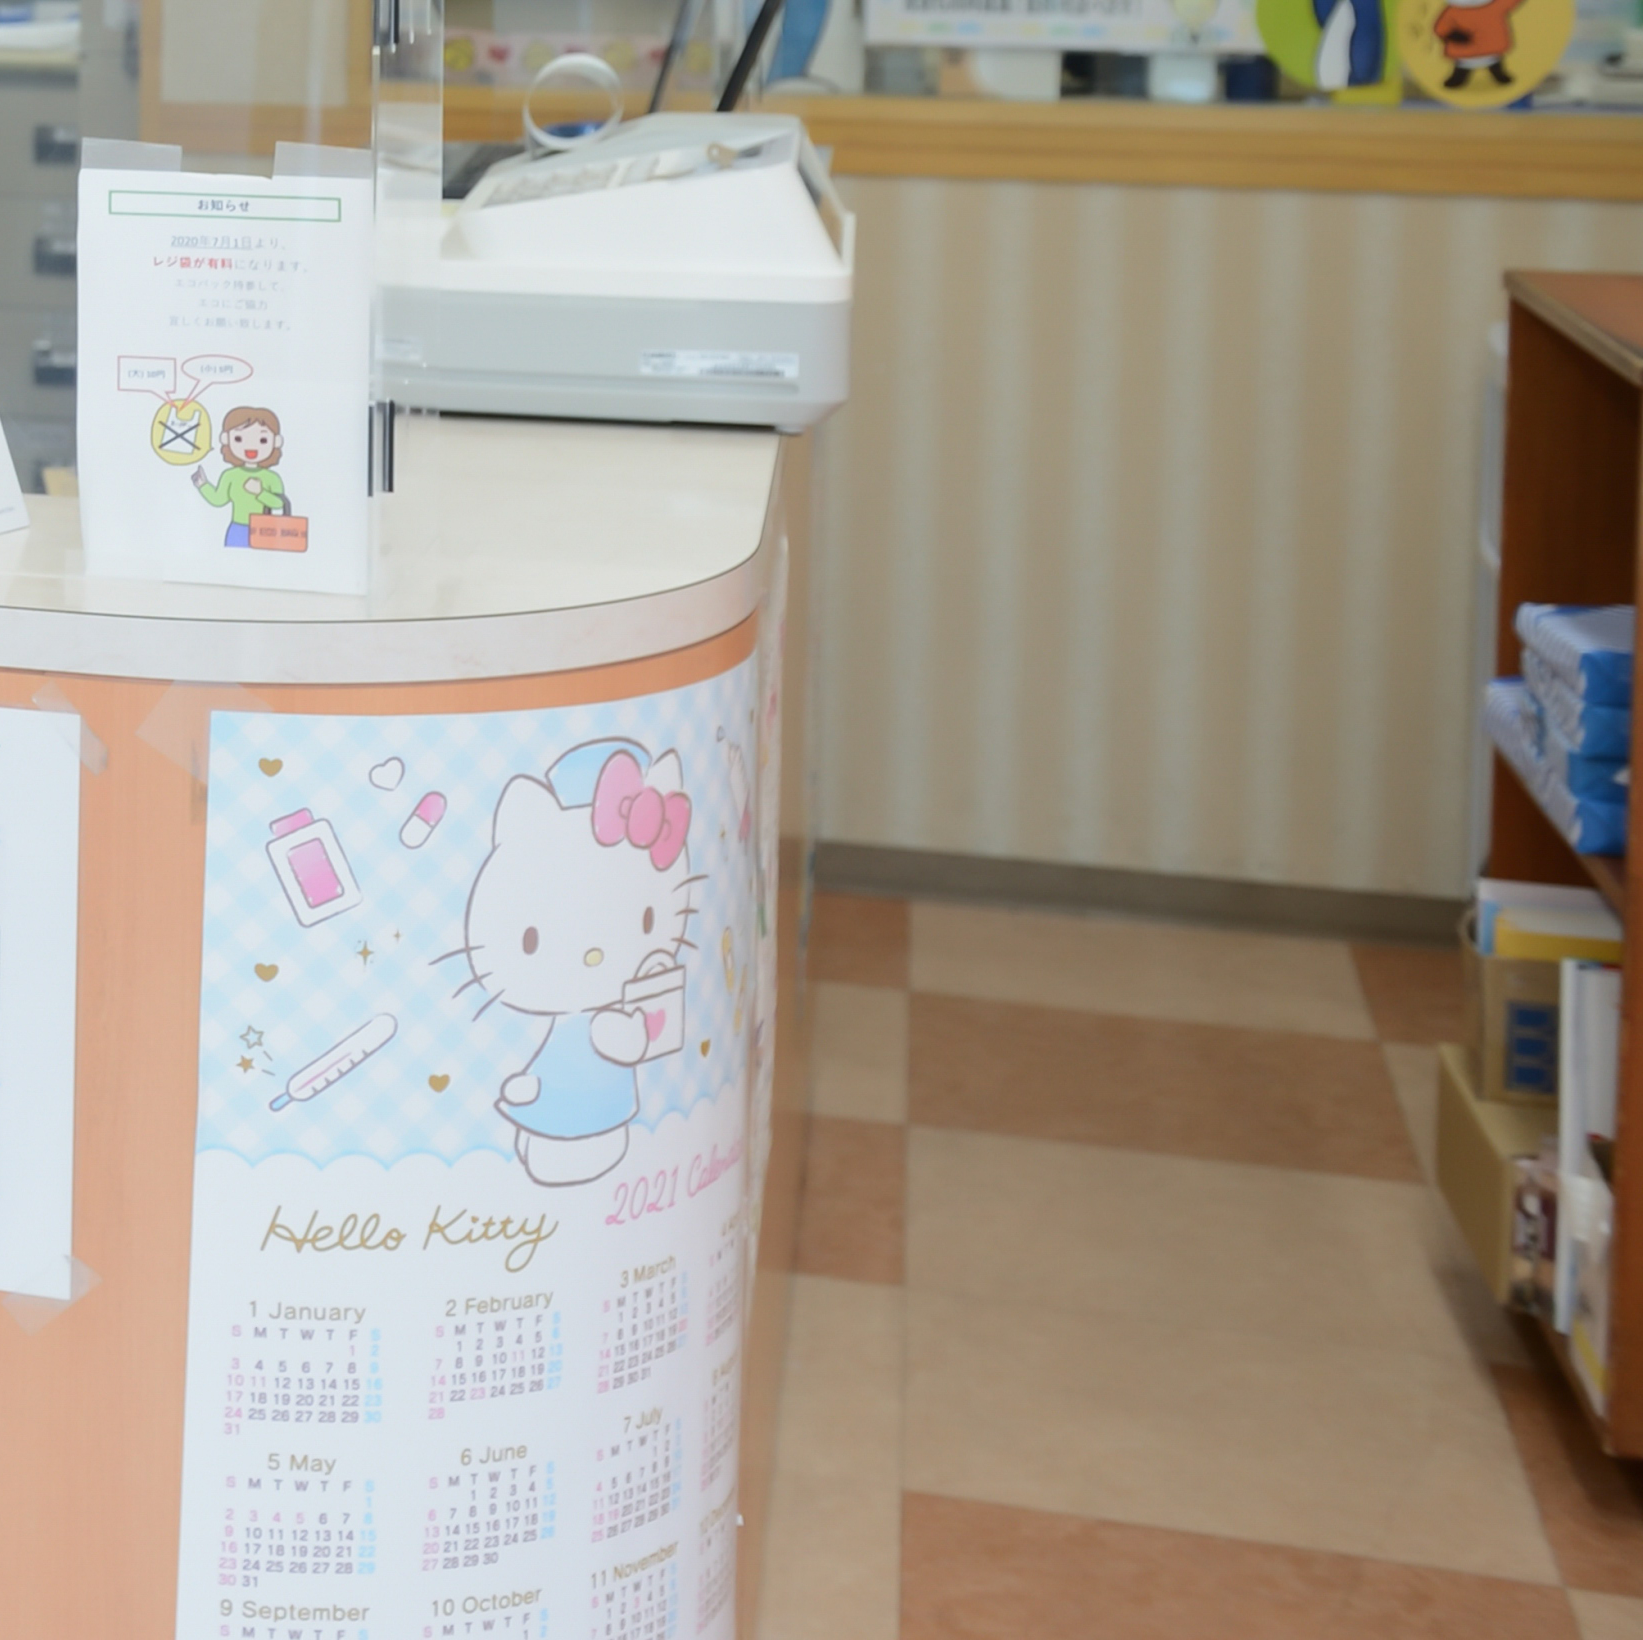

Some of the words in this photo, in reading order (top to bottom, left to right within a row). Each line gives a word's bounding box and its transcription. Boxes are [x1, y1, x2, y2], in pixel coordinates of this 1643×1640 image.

[197, 198, 250, 213] お知らせ
[605, 1165, 679, 1227] 2021
[260, 1204, 407, 1254] Hello
[421, 1204, 560, 1274] Kitty
[619, 1269, 631, 1289] 3
[632, 1254, 678, 1286] March
[248, 1299, 258, 1319] 1
[268, 1301, 368, 1326] January
[444, 1298, 458, 1318] 2
[464, 1291, 555, 1316] February
[227, 1391, 242, 1402] 17
[251, 1392, 267, 1404] 18
[274, 1394, 290, 1405] 19
[296, 1395, 314, 1406] 20
[319, 1395, 335, 1406] 21
[342, 1395, 359, 1406] 22
[622, 1415, 633, 1435] 7
[635, 1405, 665, 1432] July
[267, 1453, 281, 1471] 5
[289, 1454, 337, 1476] May
[459, 1447, 473, 1467] 6
[478, 1441, 529, 1466] June
[590, 1571, 608, 1591] 11
[613, 1539, 680, 1584] November
[220, 1598, 234, 1617] 9
[241, 1600, 370, 1624] September
[430, 1597, 455, 1618] 10
[460, 1586, 543, 1616] October
